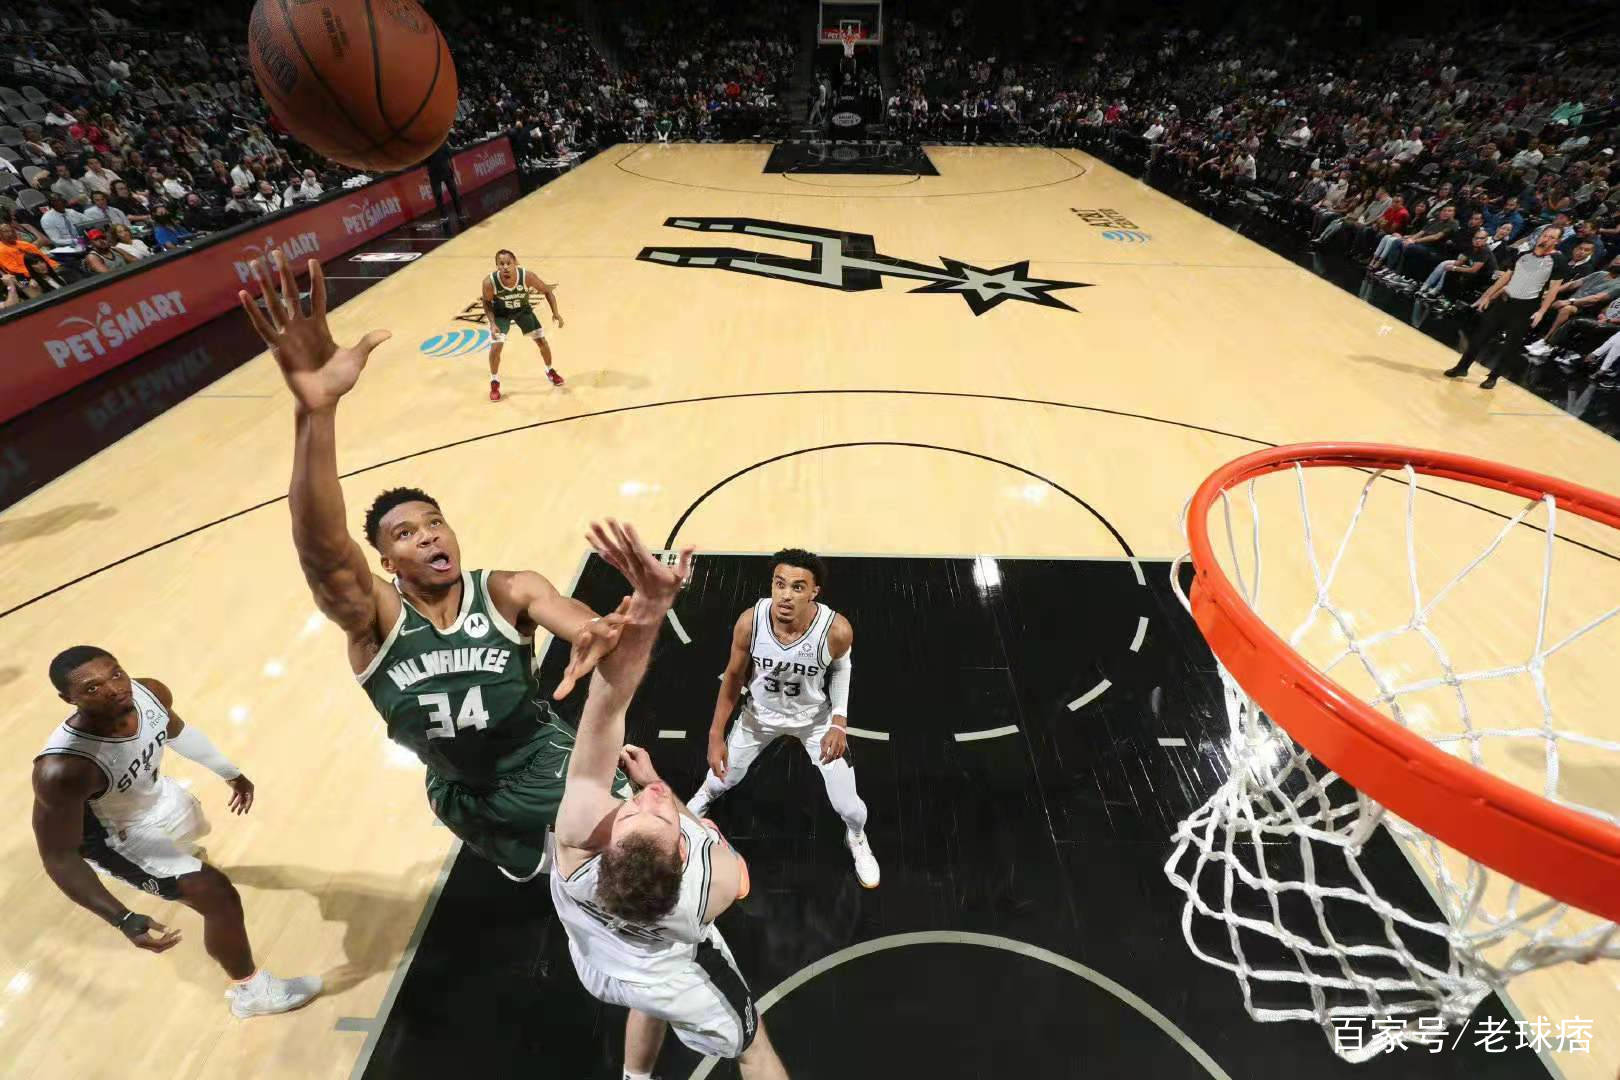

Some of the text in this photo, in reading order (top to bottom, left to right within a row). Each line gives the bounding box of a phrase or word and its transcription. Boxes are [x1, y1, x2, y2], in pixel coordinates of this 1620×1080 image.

[342, 196, 402, 235] PETSMART
[43, 290, 188, 369] PETSMART
[386, 647, 511, 692] MILWAUKEE
[764, 676, 801, 697] 33
[417, 685, 490, 741] 34
[117, 730, 166, 793] SPUR
